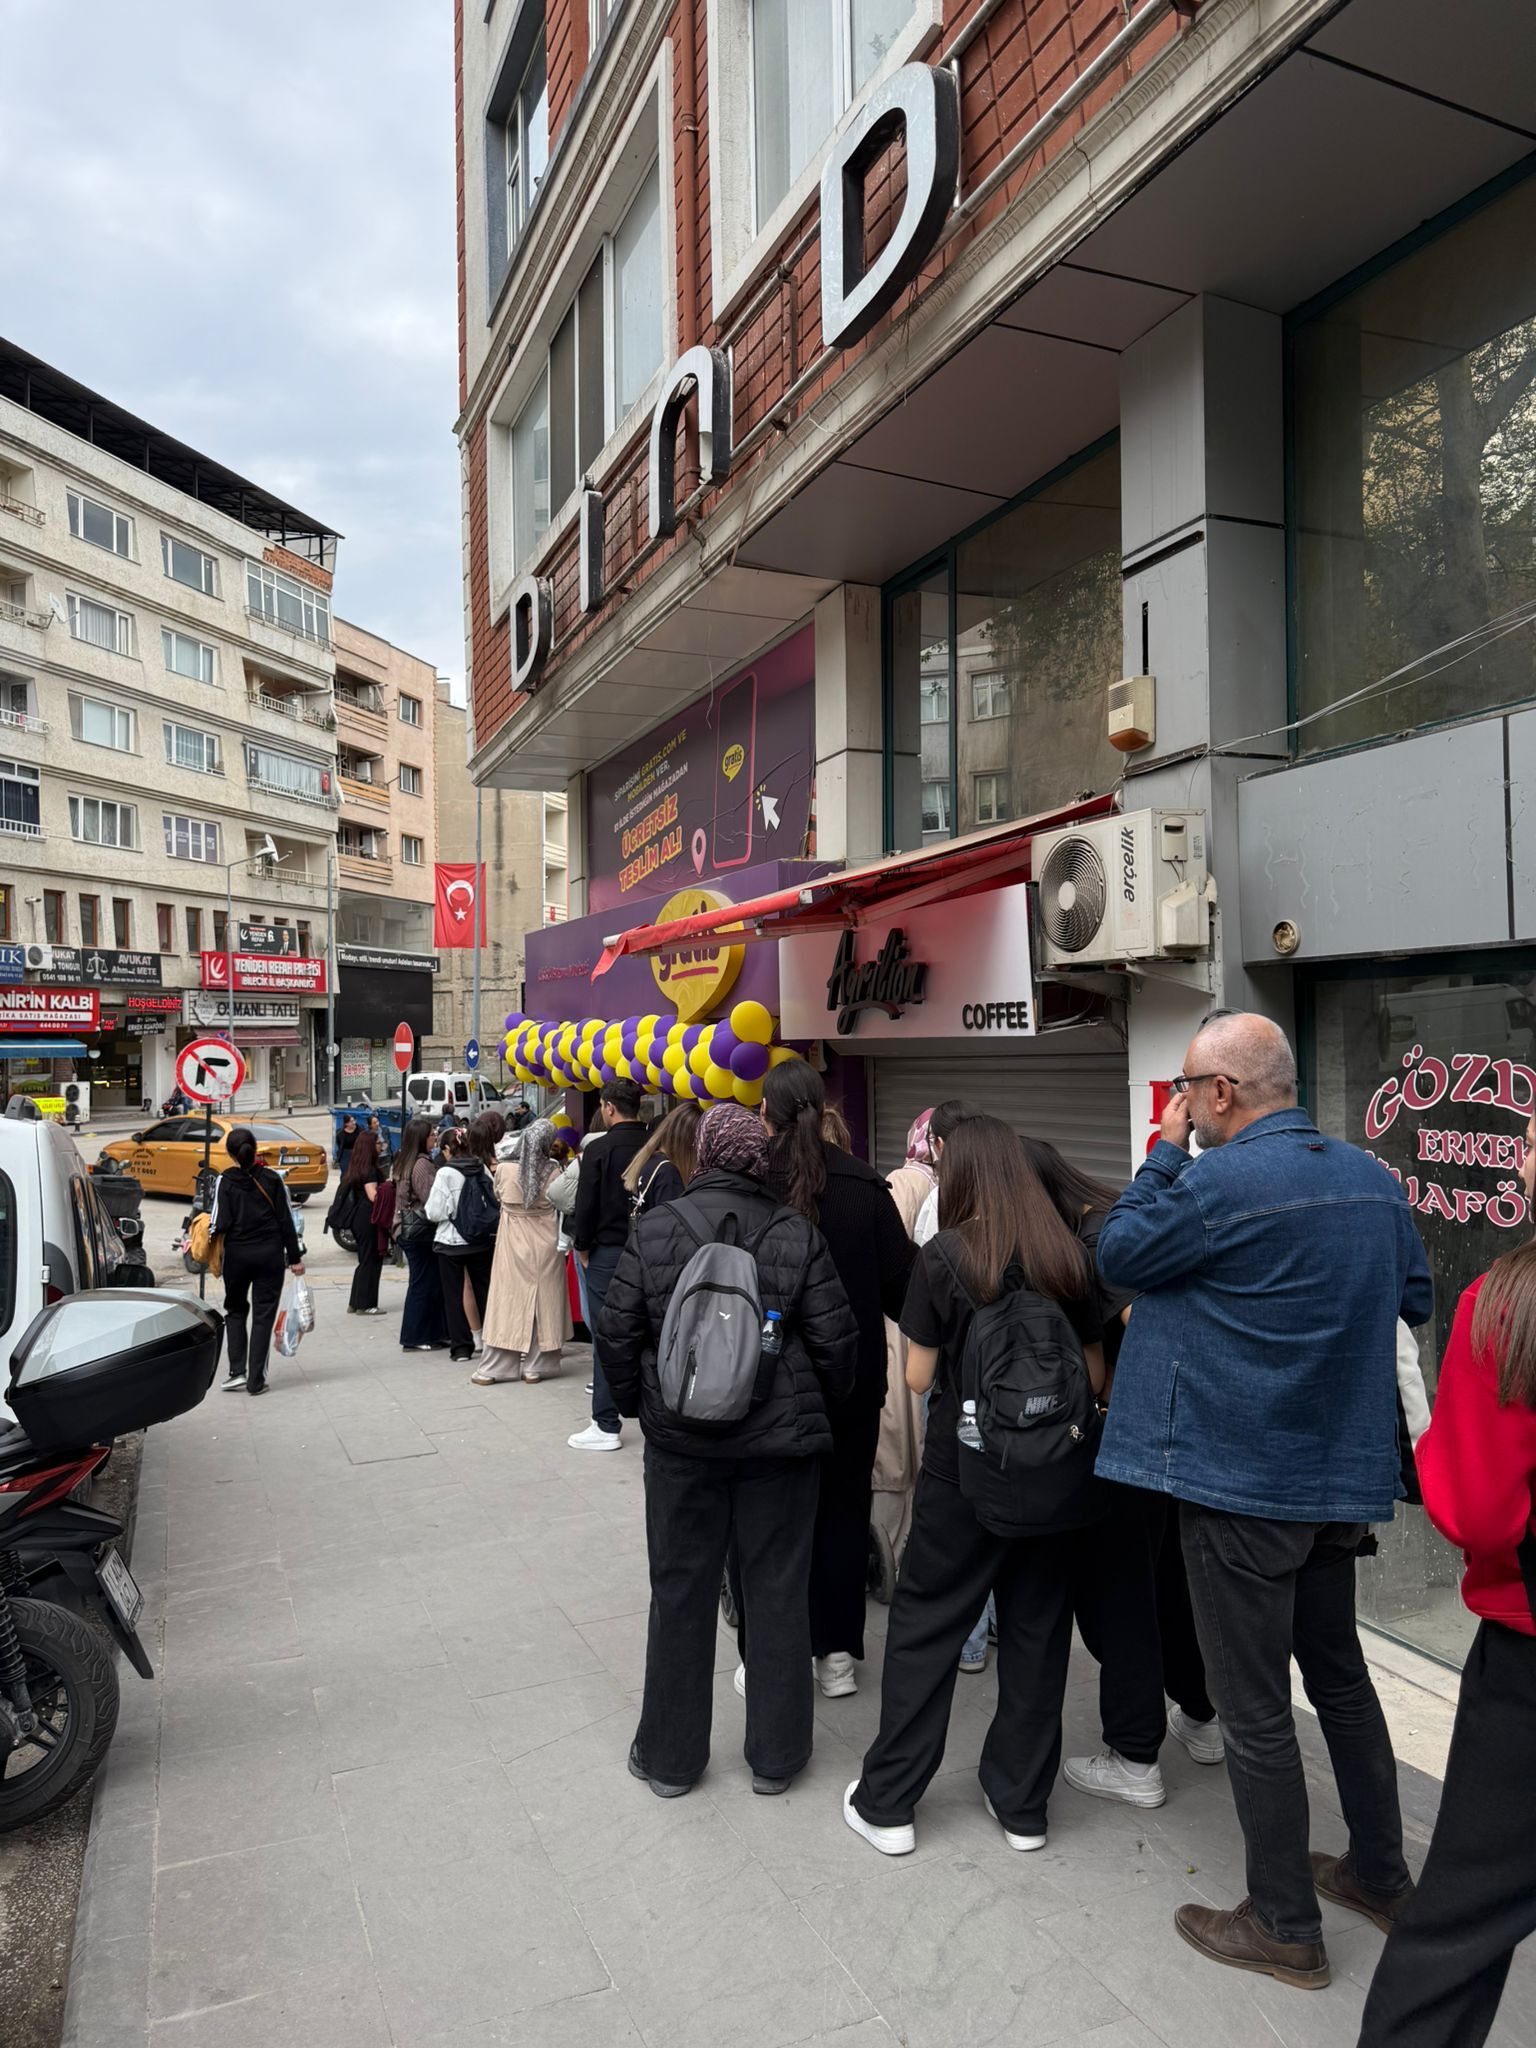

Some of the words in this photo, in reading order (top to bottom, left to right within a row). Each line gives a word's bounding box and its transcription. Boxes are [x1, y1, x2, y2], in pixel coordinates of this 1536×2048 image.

[621, 792, 678, 859] ÜCRETSİZ
[619, 843, 660, 892] TESLİM
[660, 825, 683, 865] AL!
[1121, 826, 1137, 902] arçelik
[118, 954, 152, 966] AVUKAT
[234, 957, 267, 973] YENİDEN
[268, 960, 292, 975] REFAH
[137, 967, 157, 975] METE
[241, 974, 268, 986] BİLECİK
[276, 977, 316, 989] BAŞKANLIĞI
[50, 993, 93, 1010] KALBİ
[128, 996, 183, 1009] HOŞGELDİNİZ
[217, 1002, 266, 1017] OMANLI
[271, 1003, 298, 1017] TATLI
[43, 1012, 81, 1020] MAĞAZASI
[962, 1001, 1030, 1030] COFFEE
[1024, 1394, 1058, 1415] NIKE
